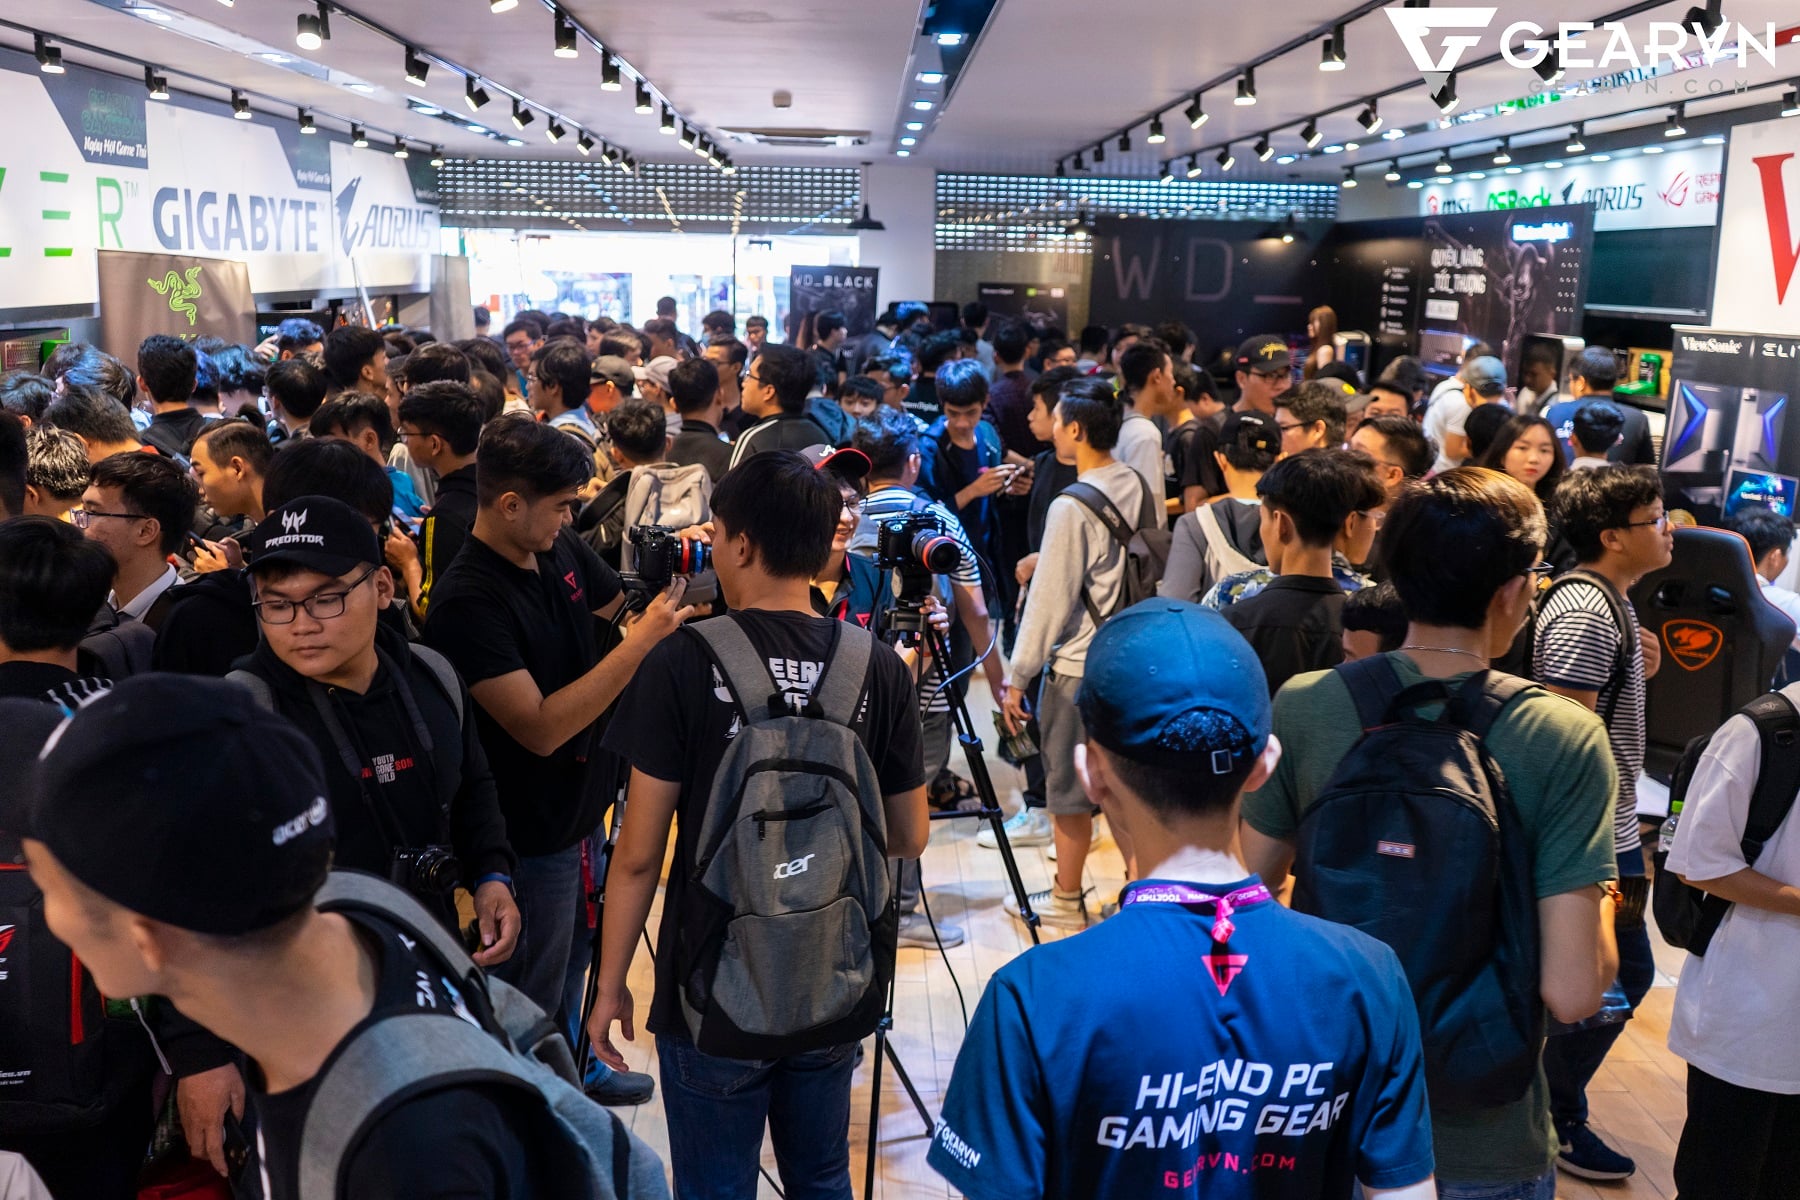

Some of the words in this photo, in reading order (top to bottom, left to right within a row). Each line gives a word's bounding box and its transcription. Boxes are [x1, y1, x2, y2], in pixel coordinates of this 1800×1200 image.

[153, 187, 318, 252] GIGABYTE
[358, 204, 434, 248] AORUS
[1681, 336, 1740, 354] ViewSonic
[265, 534, 324, 549] PREDATOR
[372, 753, 395, 766] YOUTH
[375, 763, 395, 775] GONE
[378, 771, 396, 784] WILD
[1135, 1058, 1273, 1110] HI-END
[1279, 1062, 1334, 1098] PC
[1097, 1098, 1249, 1150] GAMING
[1254, 1091, 1350, 1137] GEAR
[942, 1126, 981, 1168] GEARVN
